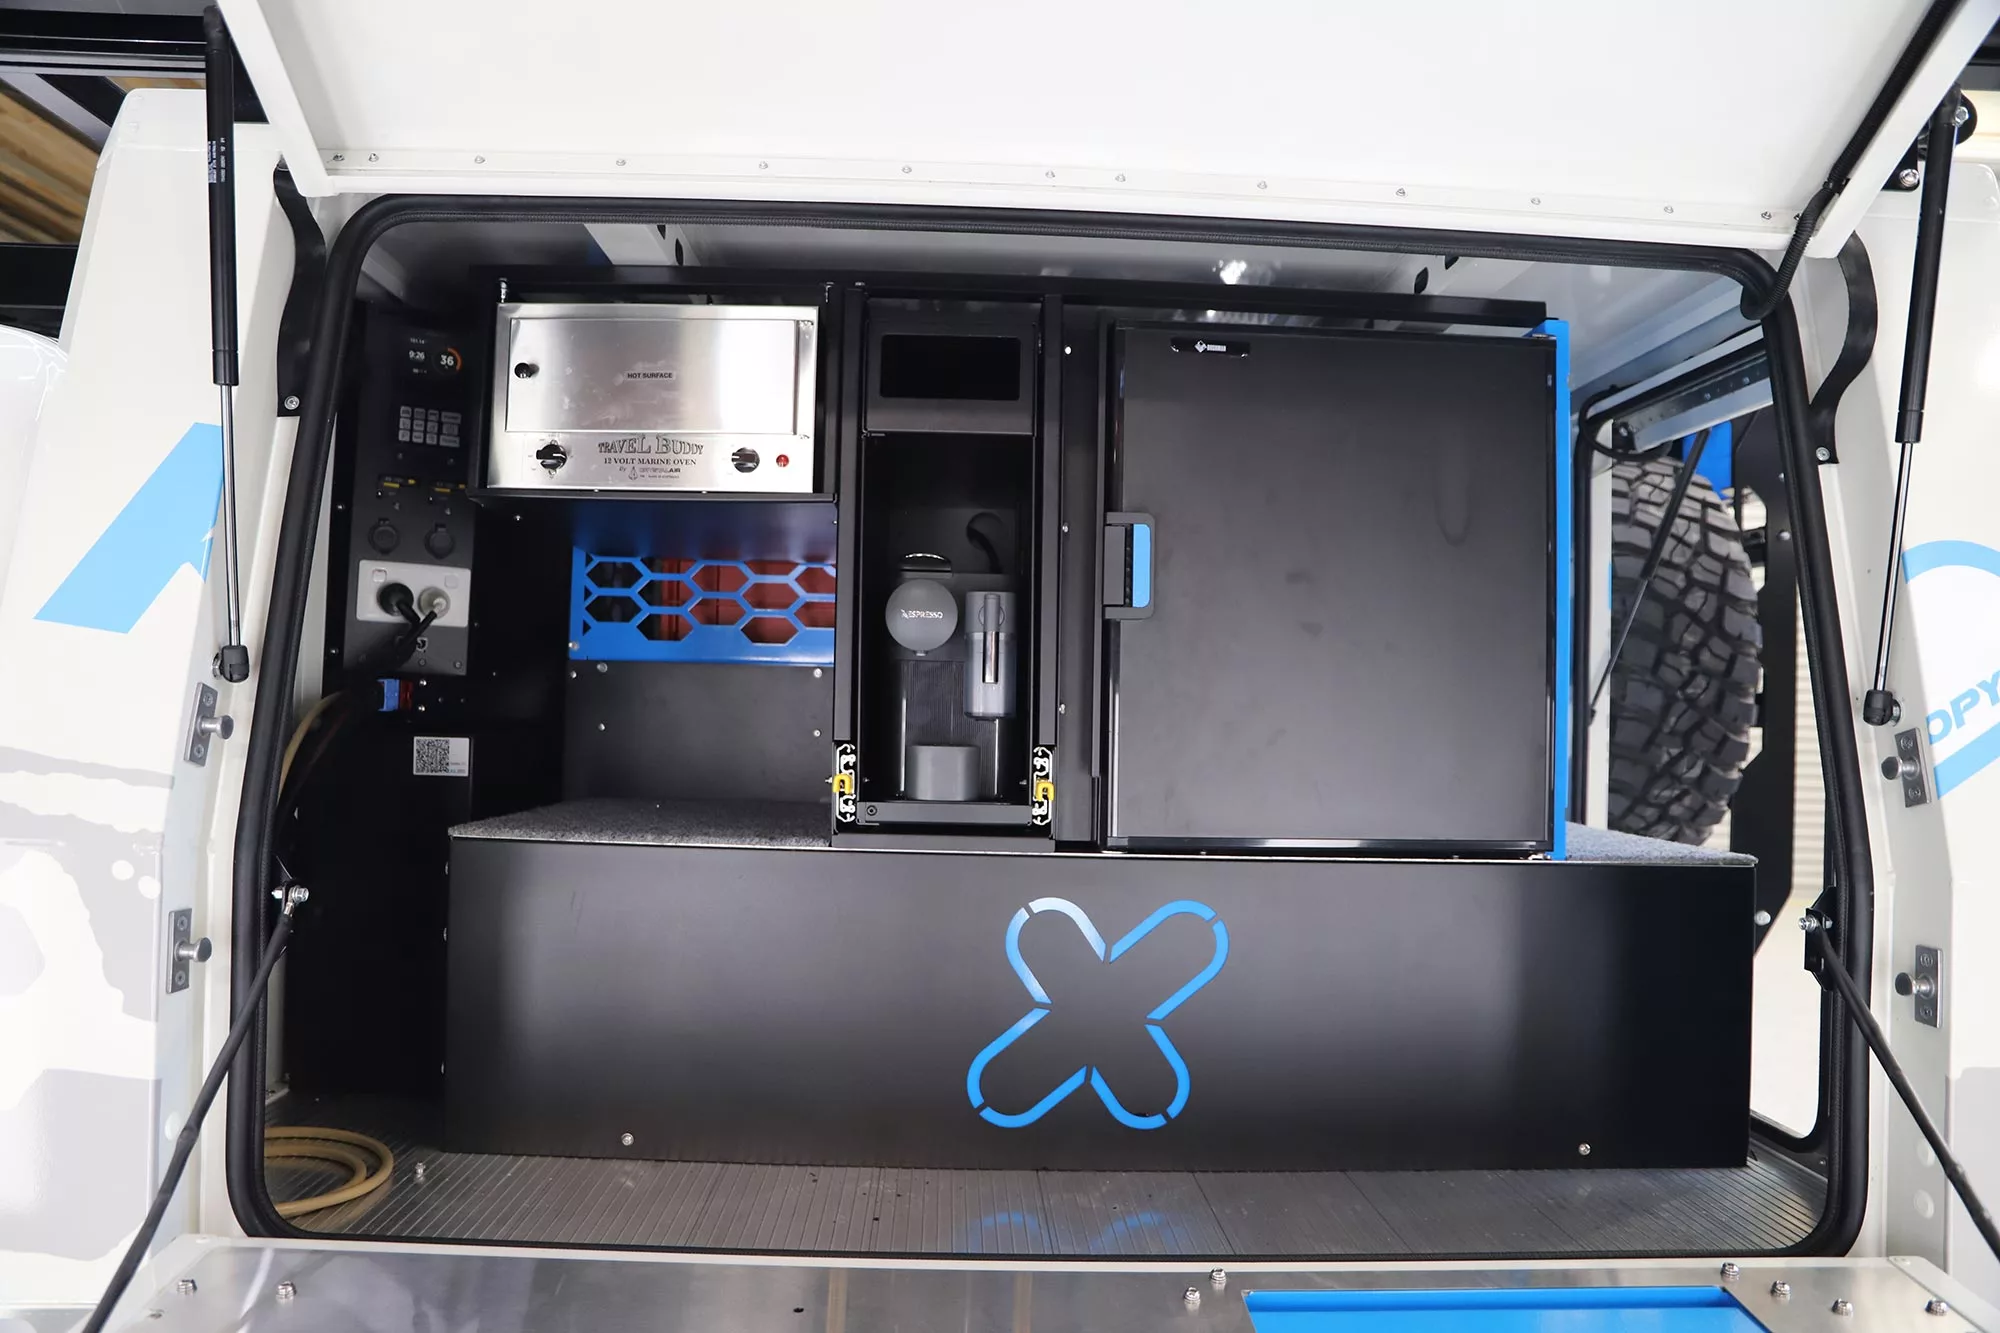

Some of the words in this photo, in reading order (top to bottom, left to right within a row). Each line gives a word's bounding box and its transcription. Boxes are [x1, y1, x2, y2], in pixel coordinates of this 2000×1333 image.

[440, 354, 454, 366] 36
[598, 433, 652, 454] TRAVEL
[655, 433, 704, 455] BUDDY
[604, 457, 612, 465] 12
[673, 458, 697, 466] OVEN
[900, 609, 944, 620] NESPRESSO
